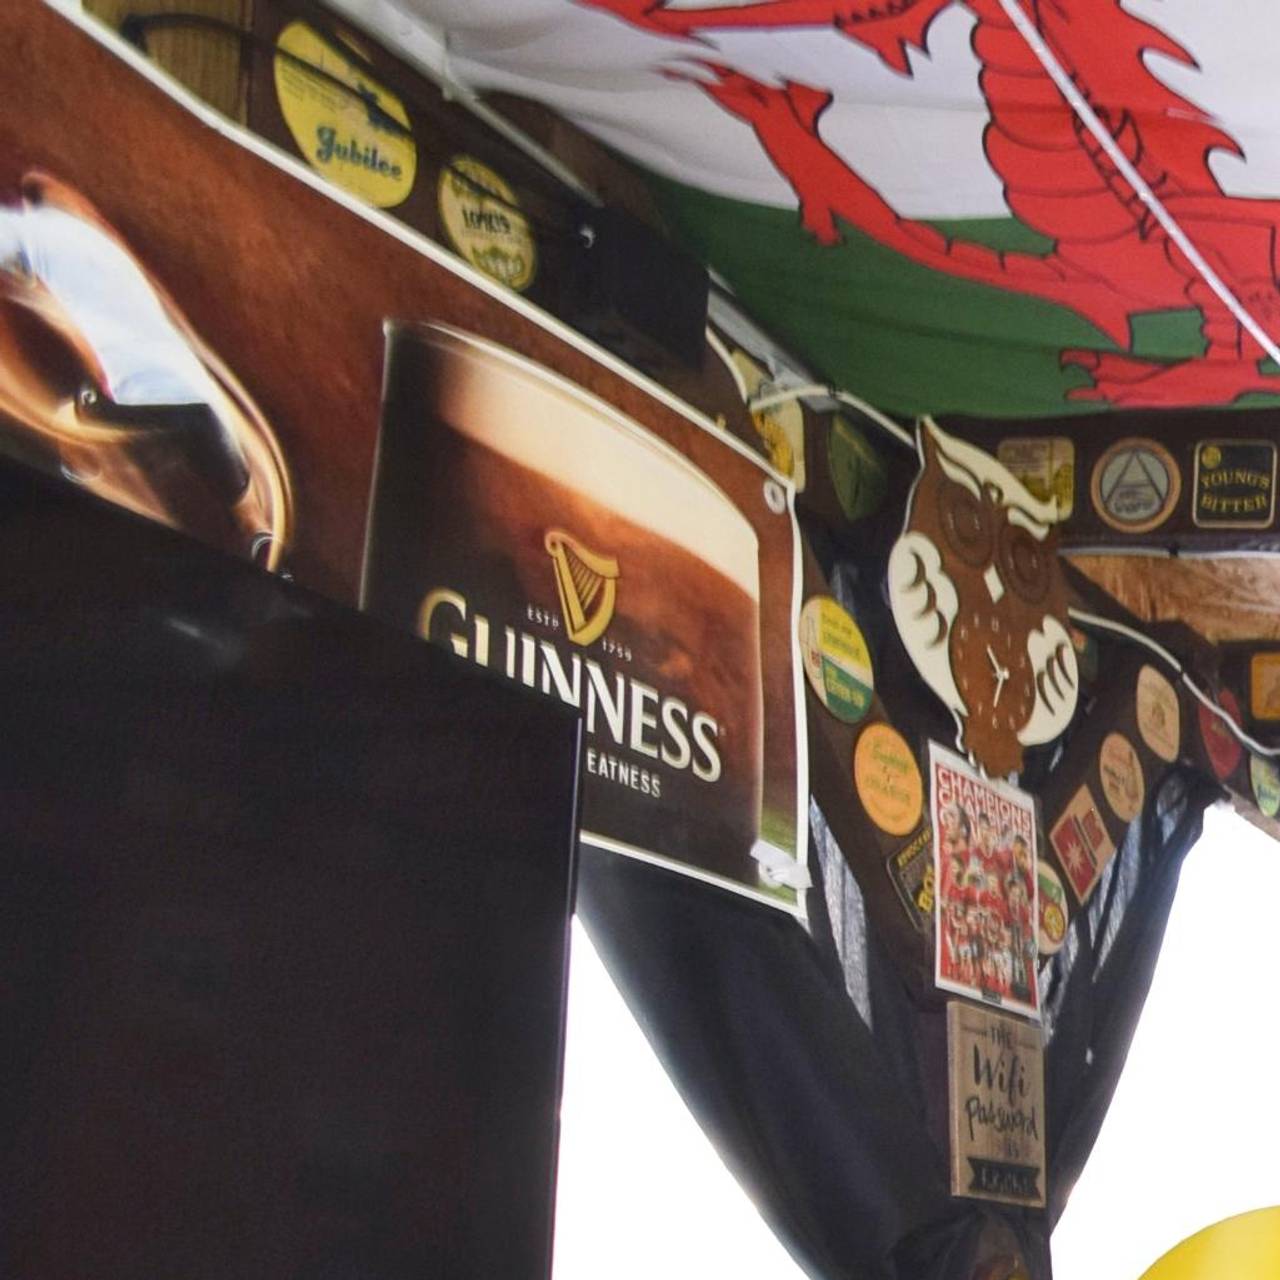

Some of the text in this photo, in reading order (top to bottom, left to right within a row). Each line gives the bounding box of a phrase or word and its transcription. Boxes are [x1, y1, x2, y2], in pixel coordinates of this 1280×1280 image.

[316, 126, 403, 182] Jubilee
[601, 638, 633, 661] 1759
[418, 586, 723, 784] GUINNESS
[586, 750, 662, 799] EATNESS
